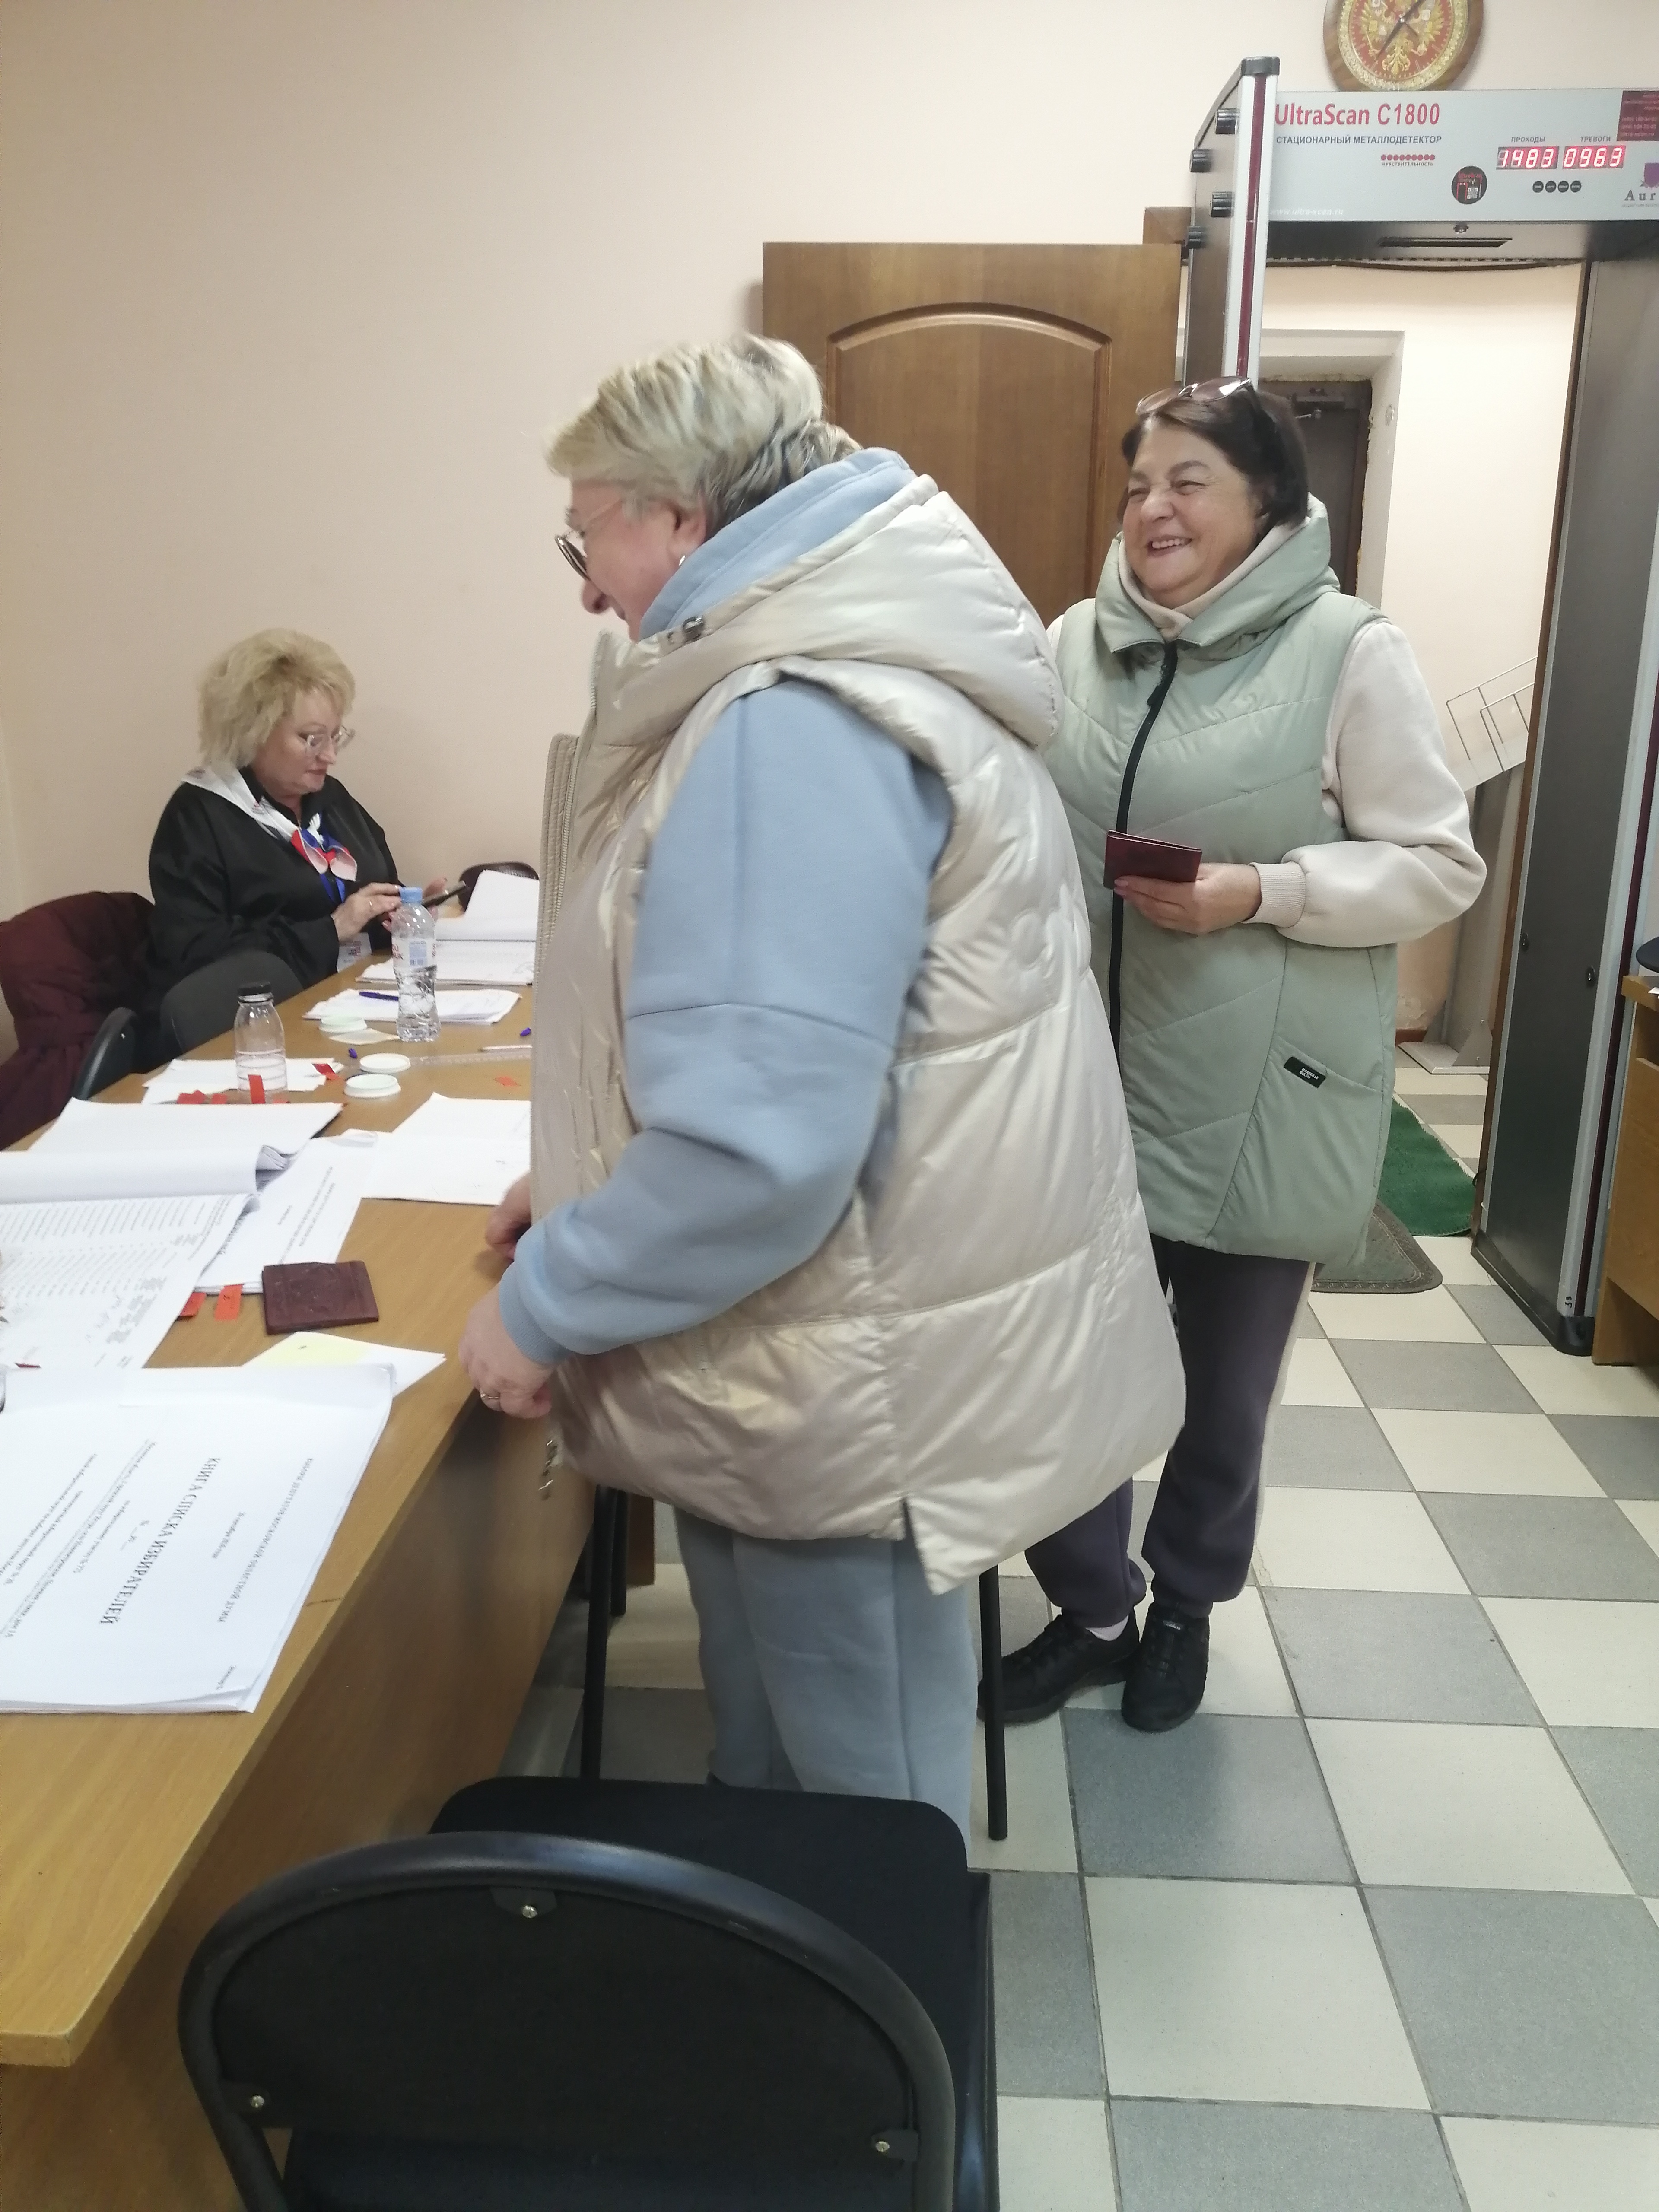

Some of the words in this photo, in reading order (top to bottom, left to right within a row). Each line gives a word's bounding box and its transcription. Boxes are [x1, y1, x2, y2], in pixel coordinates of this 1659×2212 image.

[1275, 102, 1370, 125] UltraScan
[1276, 135, 1351, 144] СТАЦИОНАРНЫЙ
[1353, 135, 1442, 144] МЕТАЛЛОДЕТЕКТОР
[1501, 148, 1554, 168] 1483
[1563, 147, 1623, 167] 0963
[189, 1457, 221, 1492] КНИГА
[157, 1494, 197, 1538] СПИСКА
[100, 1539, 168, 1624] ИЗБИРАТЕЛЕЙ
